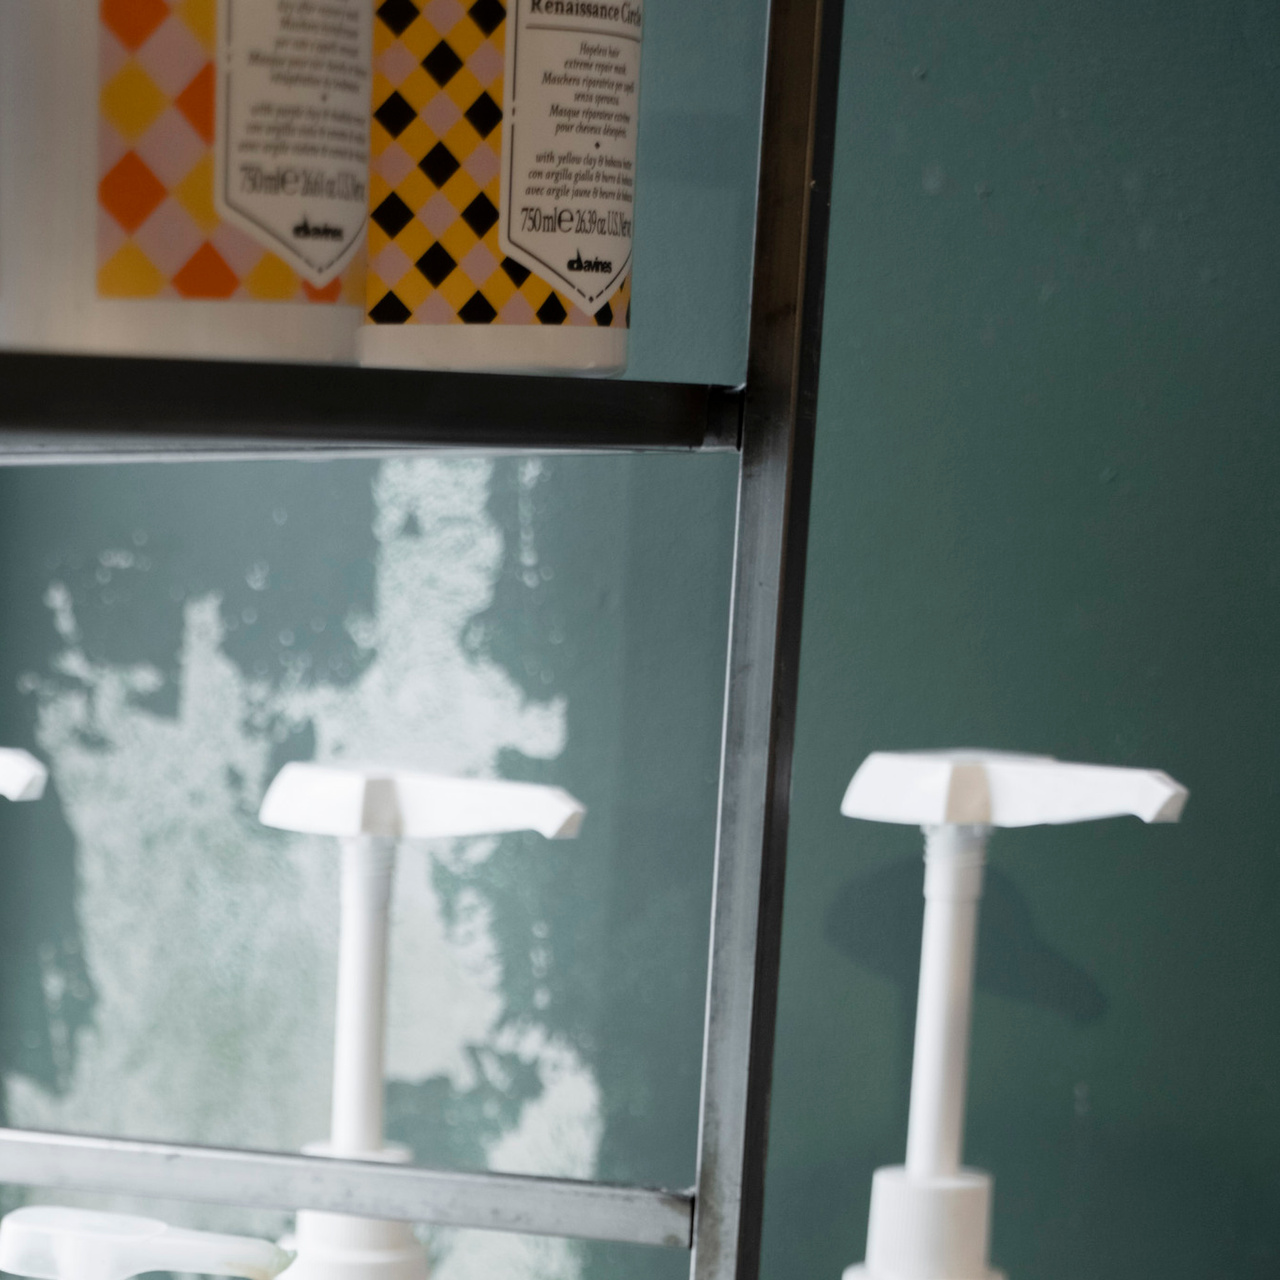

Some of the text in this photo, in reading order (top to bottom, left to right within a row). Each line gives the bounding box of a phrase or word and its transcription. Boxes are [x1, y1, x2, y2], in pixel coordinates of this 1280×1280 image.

[530, 0, 619, 21] Renaissance
[564, 59, 593, 71] extreme
[541, 71, 580, 86] Maschera
[549, 104, 580, 120] Masque
[535, 151, 555, 163] with
[557, 152, 580, 167] yellow
[528, 169, 544, 180] con
[525, 185, 544, 196] avec
